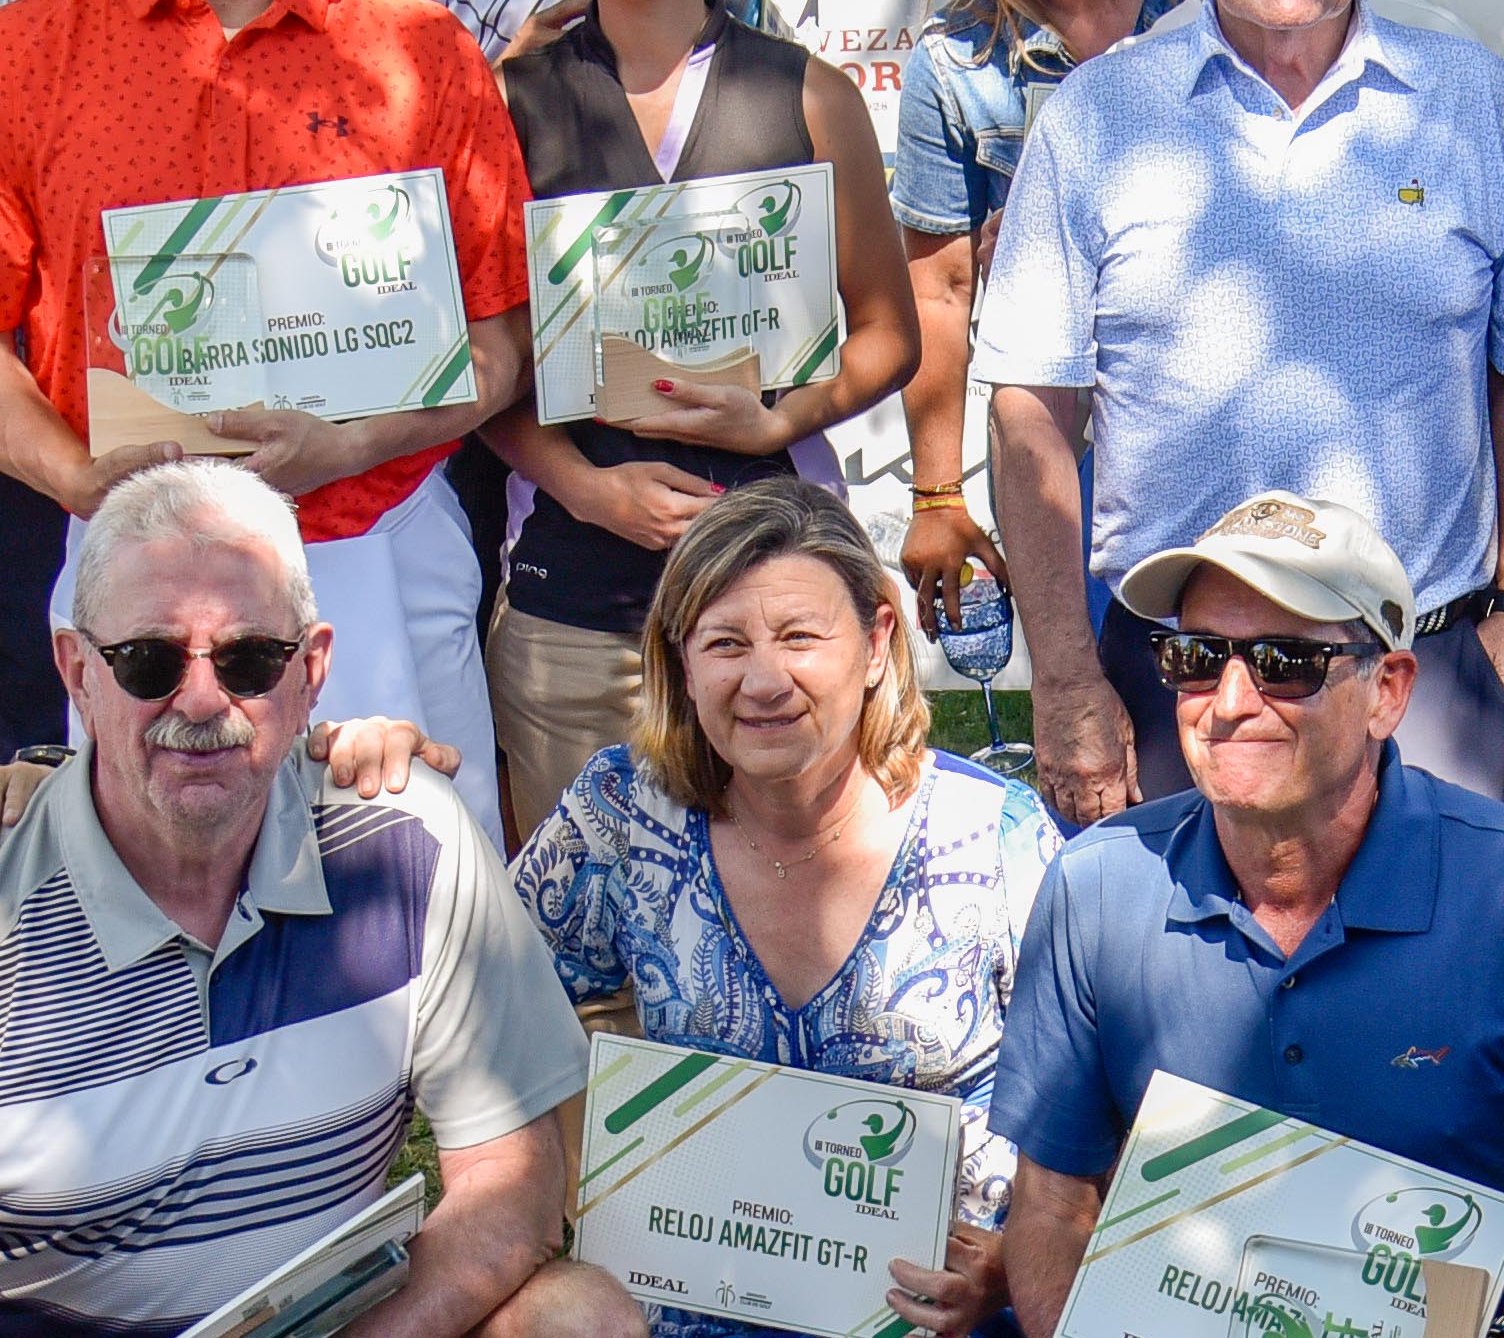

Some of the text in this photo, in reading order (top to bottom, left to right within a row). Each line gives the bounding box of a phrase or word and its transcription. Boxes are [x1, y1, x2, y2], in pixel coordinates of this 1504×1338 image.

[341, 248, 411, 288] GOLF
[764, 271, 799, 282] IDEAL
[377, 282, 417, 294] IDEAL
[641, 284, 672, 296] TORNEO
[131, 323, 169, 335] TORNEO
[268, 312, 325, 331] PREMIO:
[182, 320, 416, 373] BARRA SONIDO LG SQC2
[169, 376, 212, 386] IDEAL
[825, 1141, 862, 1158] TORNEO
[824, 1157, 904, 1207] GOLF
[732, 1200, 793, 1225] PREMIO:
[856, 1203, 899, 1221] IDEAL
[649, 1205, 868, 1273] RELOJ AMAZFIT GT-R
[1374, 1226, 1414, 1249] TORNEO
[629, 1271, 688, 1294] IDEAL
[1362, 1243, 1427, 1305] GOL
[1158, 1264, 1232, 1315] RELOJ
[1254, 1272, 1320, 1309] PREMIO:
[1390, 1296, 1427, 1319] IDEA
